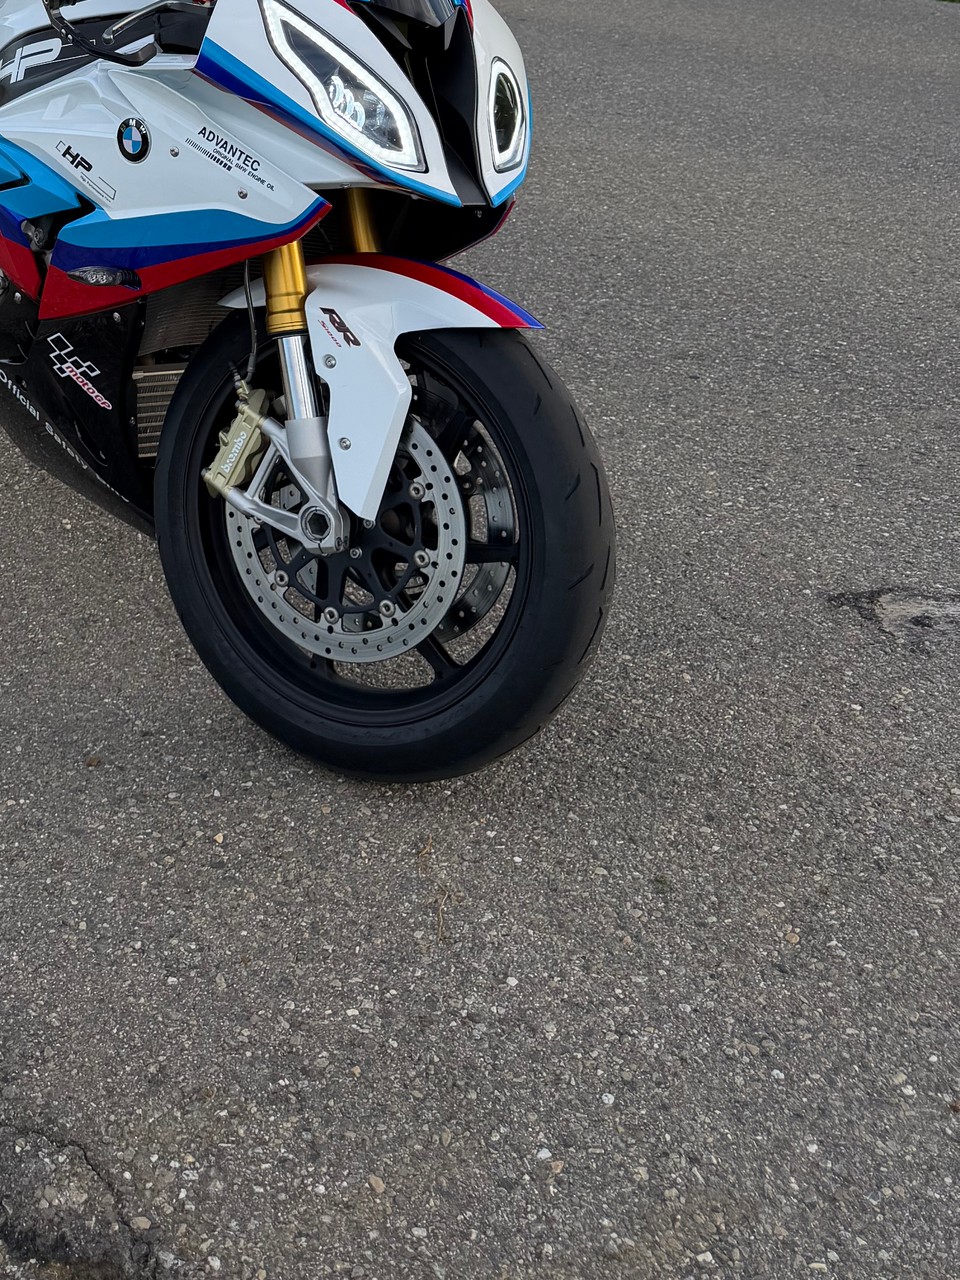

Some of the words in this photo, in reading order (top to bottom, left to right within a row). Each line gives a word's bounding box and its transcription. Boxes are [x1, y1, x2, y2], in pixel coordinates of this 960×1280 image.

[61, 145, 93, 172] HP
[197, 126, 261, 172] ADVANTEC
[212, 147, 234, 166] ORIGINAL
[234, 162, 249, 174] BMW
[247, 170, 267, 186] ENGINE
[266, 182, 275, 192] OIL
[319, 306, 361, 348] RR
[220, 431, 247, 473] brembo
